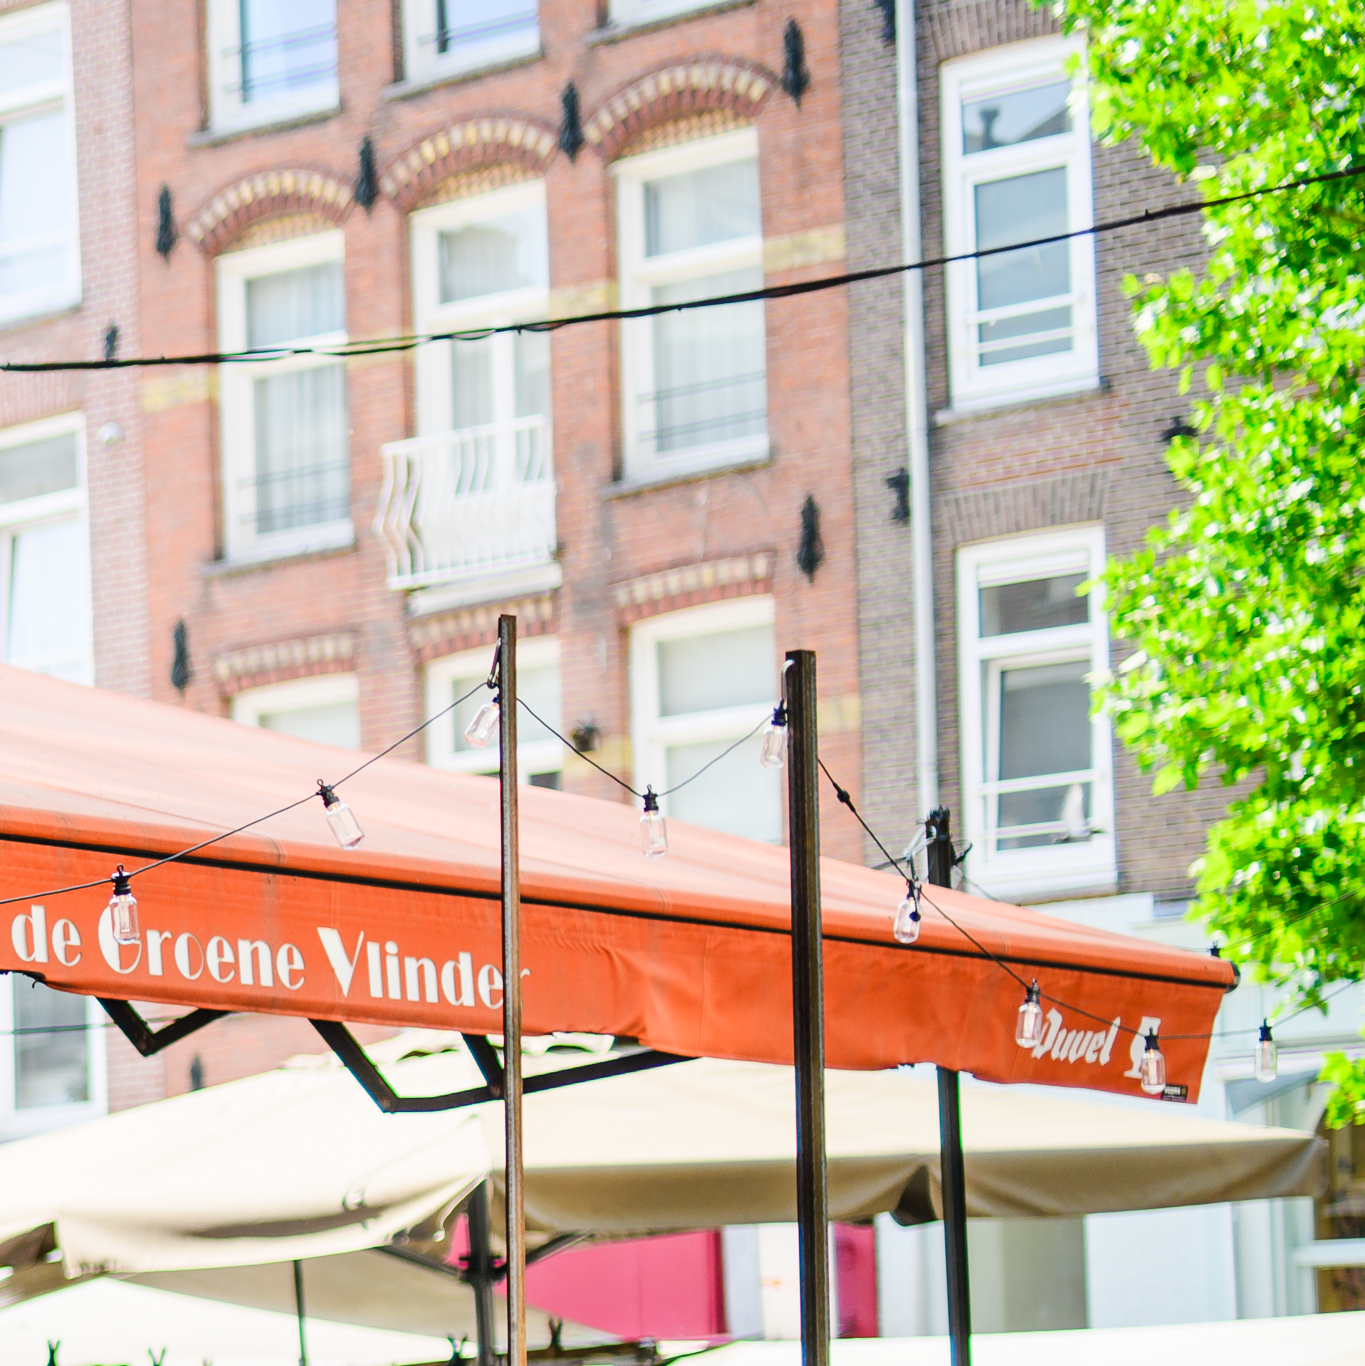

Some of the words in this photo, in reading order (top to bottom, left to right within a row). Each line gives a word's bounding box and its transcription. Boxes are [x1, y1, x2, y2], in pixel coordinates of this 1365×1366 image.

[11, 904, 82, 967] de
[97, 902, 306, 990] Groene
[1031, 1007, 1121, 1066] Duvel
